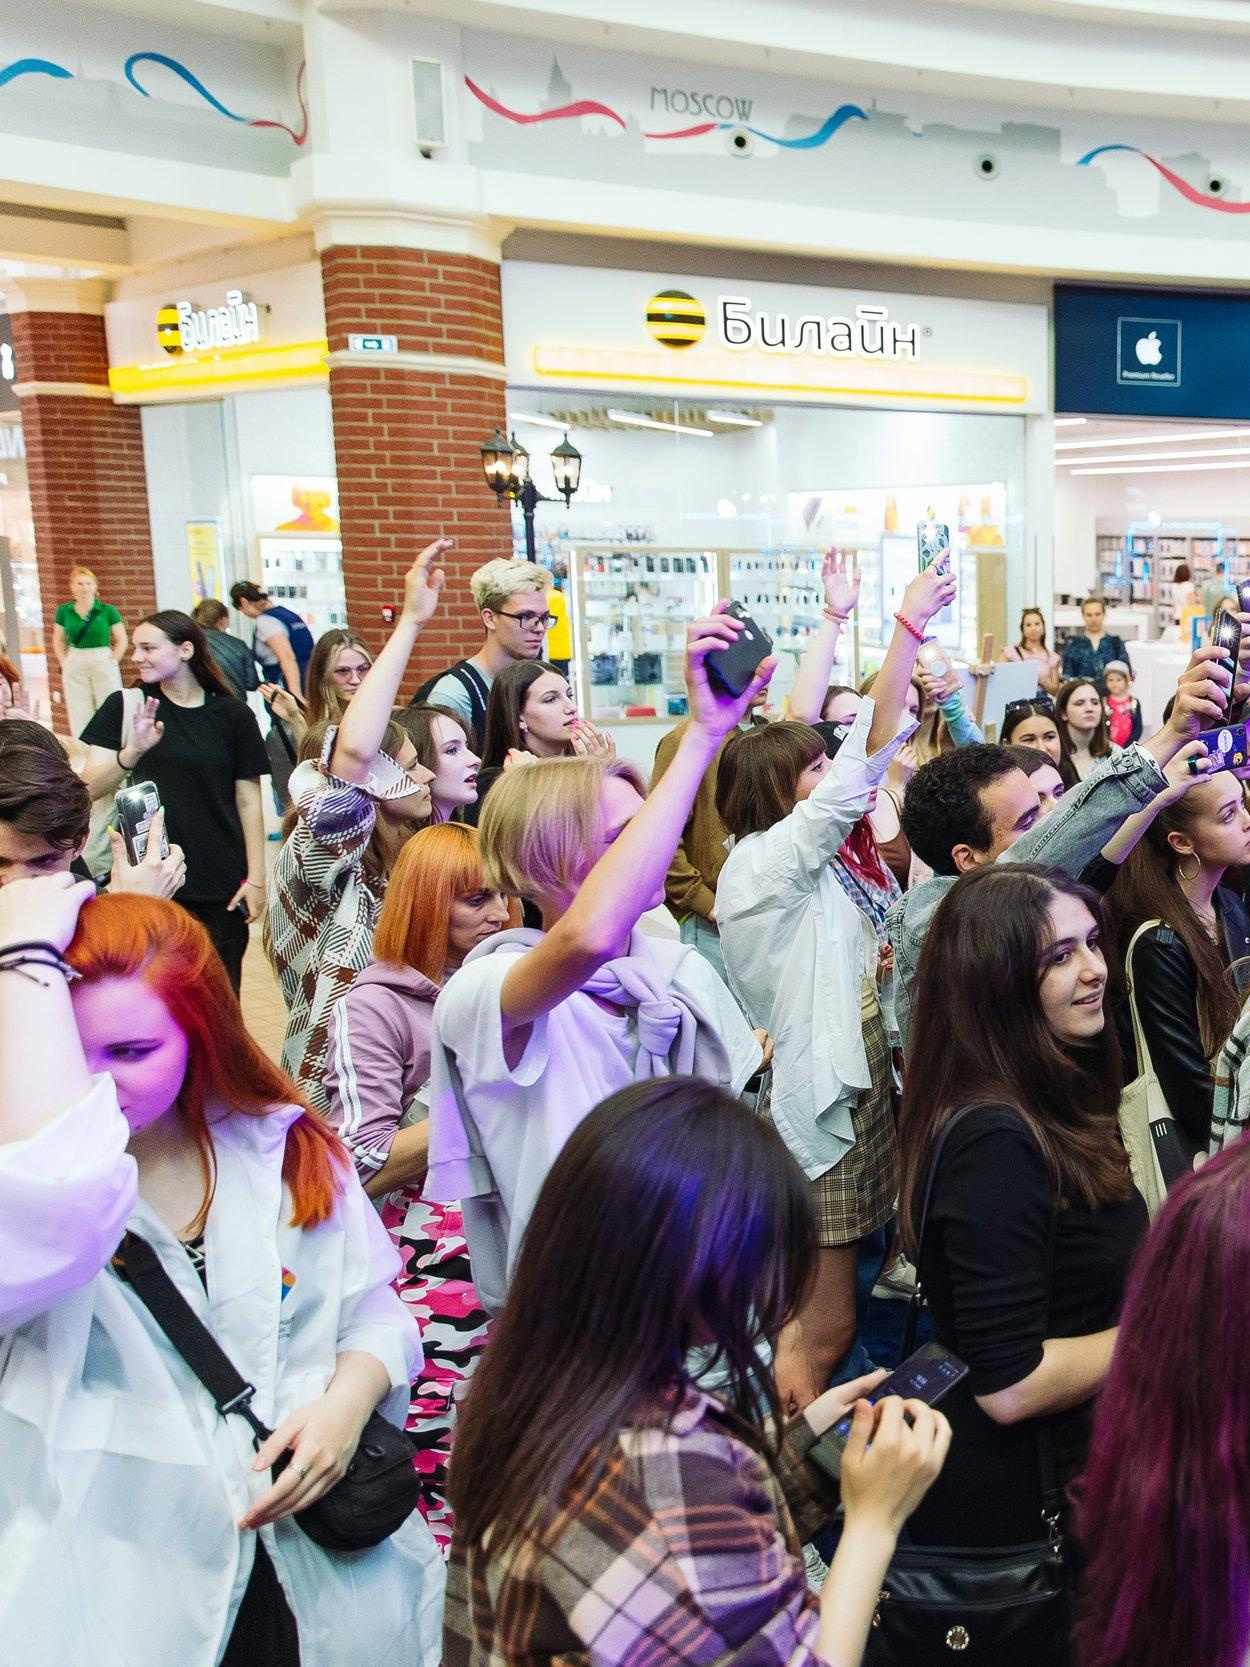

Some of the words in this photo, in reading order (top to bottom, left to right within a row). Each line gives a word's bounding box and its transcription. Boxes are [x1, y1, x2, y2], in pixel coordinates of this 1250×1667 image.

[650, 86, 753, 121] MOSCOW
[177, 290, 259, 352] Билайн
[719, 297, 919, 359] Билайн
